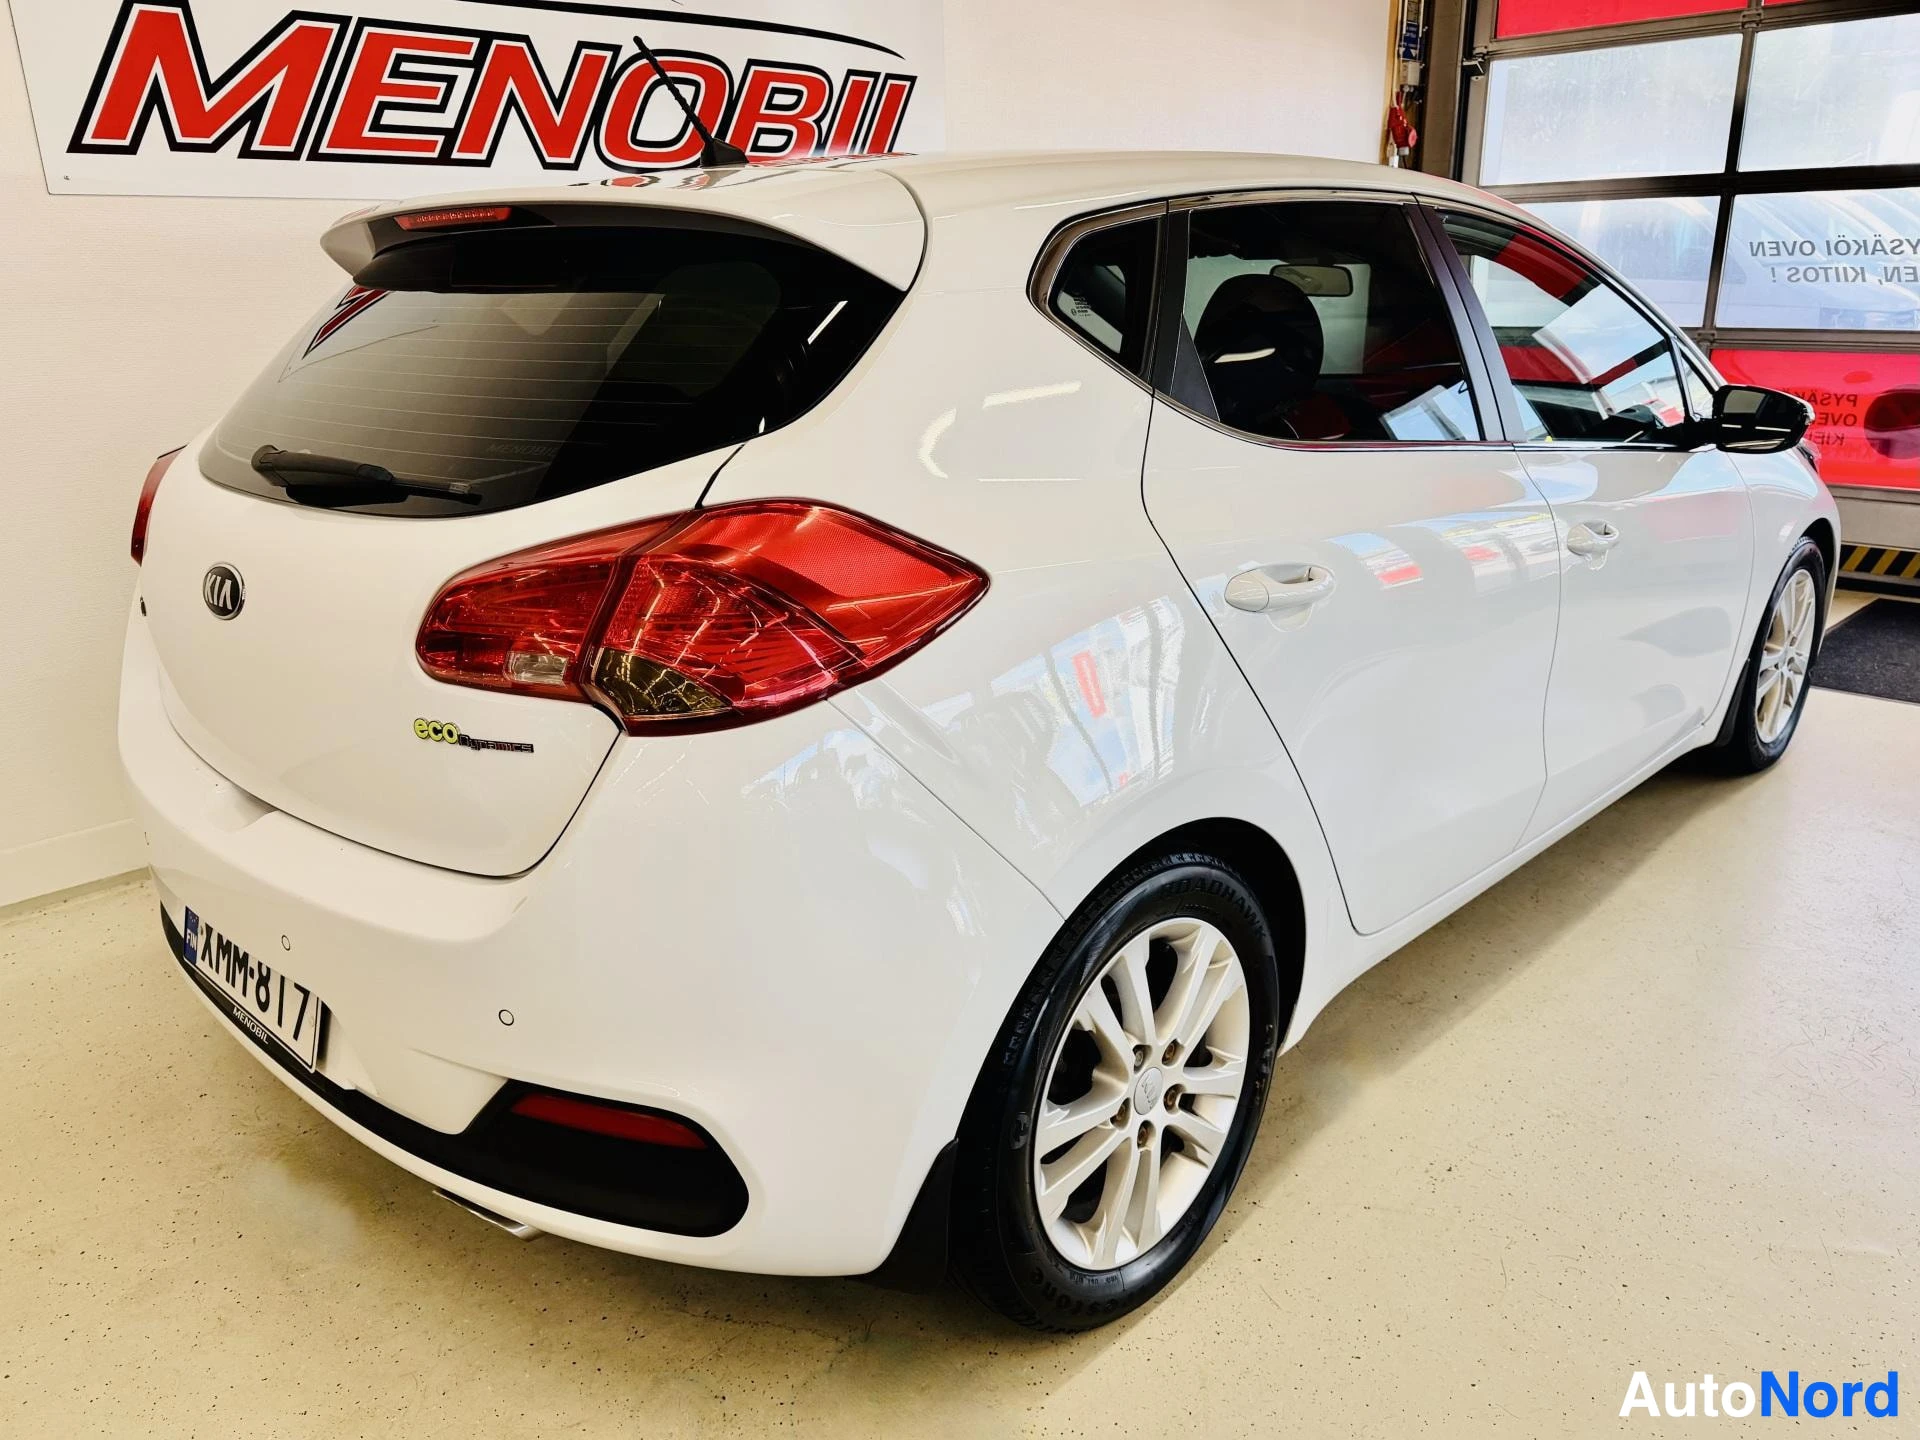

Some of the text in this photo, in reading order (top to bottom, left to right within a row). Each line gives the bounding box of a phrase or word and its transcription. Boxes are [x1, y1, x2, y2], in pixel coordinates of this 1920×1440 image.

[204, 572, 232, 610] KIA
[186, 929, 198, 951] FIN
[201, 922, 311, 1042] XMM-817
[232, 1006, 270, 1045] MENOBIL
